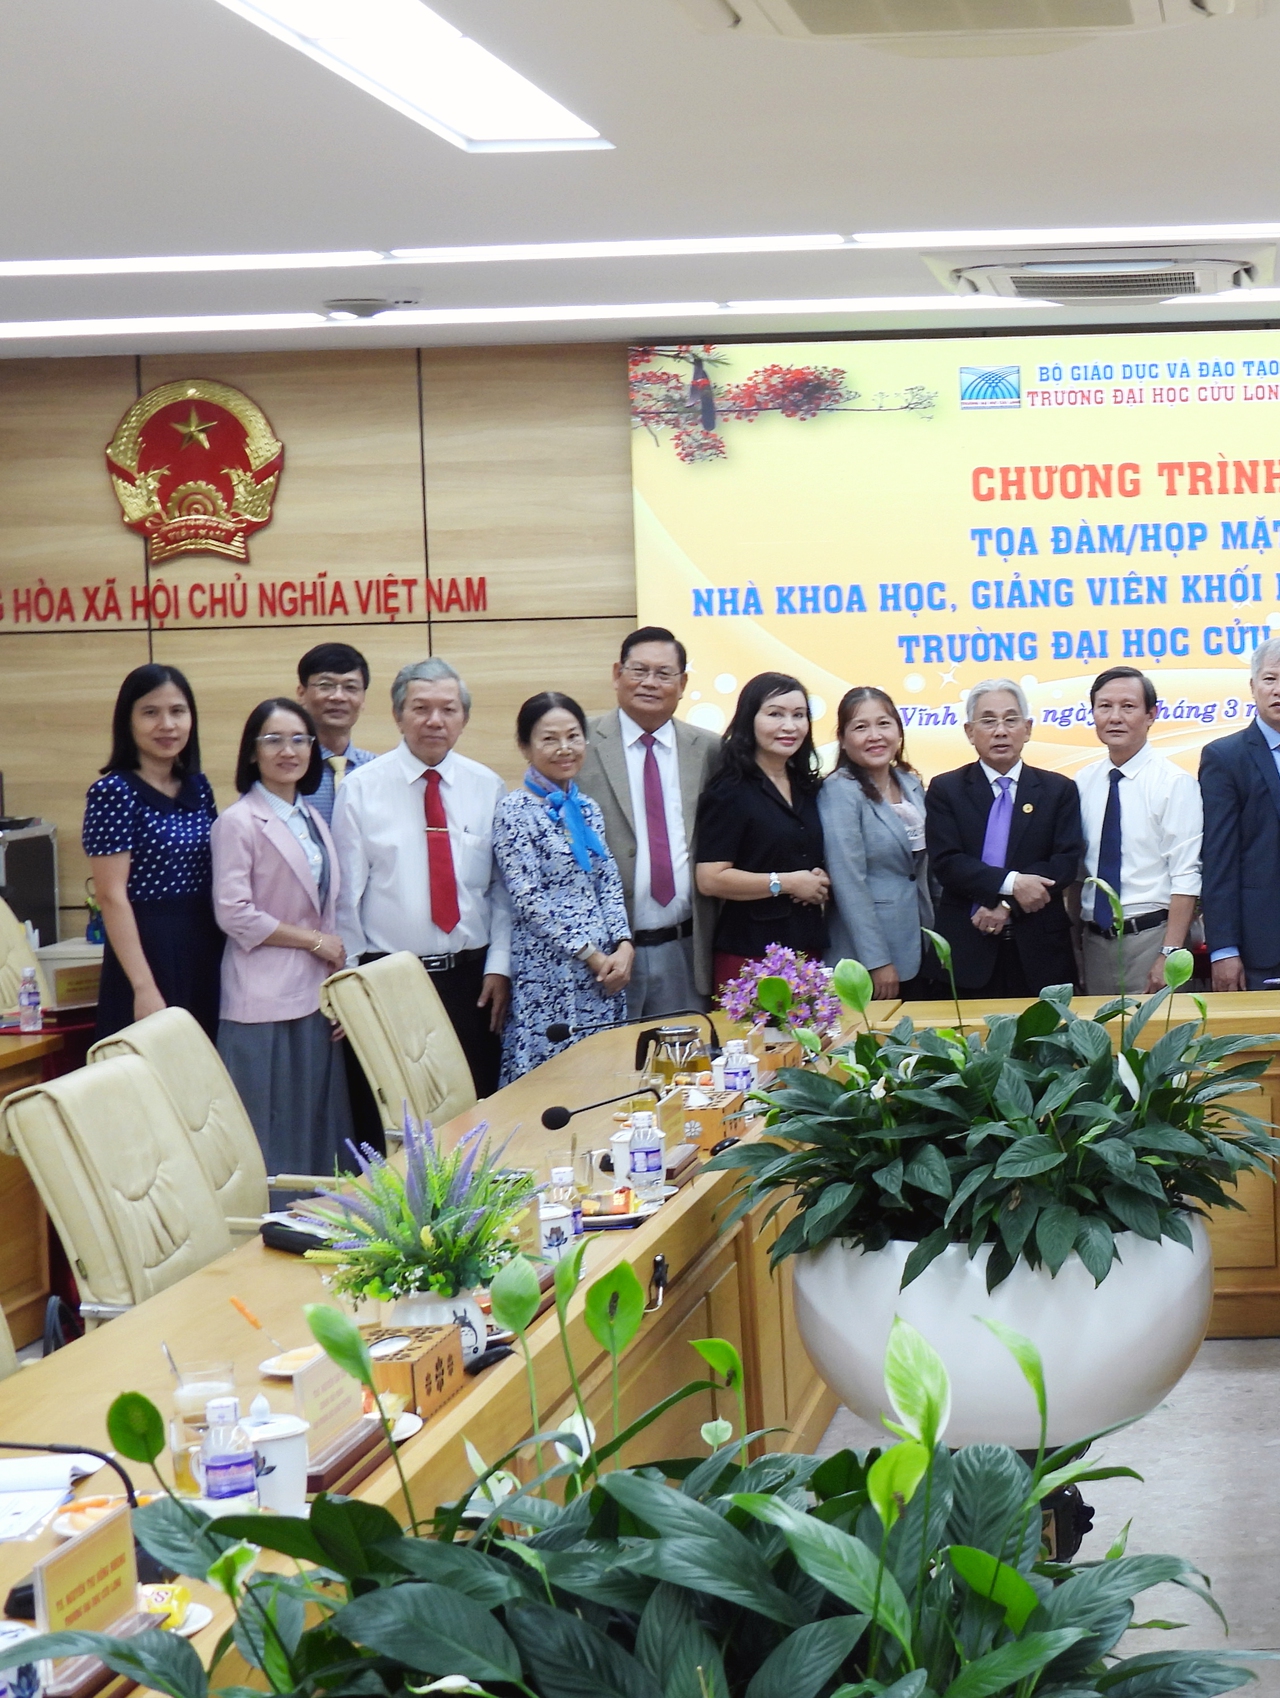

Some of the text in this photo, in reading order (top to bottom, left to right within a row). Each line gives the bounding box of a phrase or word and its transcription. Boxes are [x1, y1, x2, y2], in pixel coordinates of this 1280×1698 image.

[1039, 358, 1279, 386] BỘ GIÁO DỤC VÀ ĐÀO TẠO
[1027, 386, 1104, 406] TRƯỜNG
[1112, 388, 1144, 408] ĐẠI
[1152, 387, 1189, 407] HỌC
[1198, 381, 1235, 401] CỬU
[972, 462, 1141, 502] CHƯƠNG
[970, 526, 1039, 562] TỌA
[1050, 519, 1208, 558] ĐÀM/HỌP
[11, 577, 76, 623] HÒA
[81, 577, 123, 622] XÃ
[130, 578, 180, 629] HỘI
[187, 573, 248, 619] CHỦ
[258, 571, 349, 618] NGHĨA
[354, 573, 418, 623] VIỆT
[426, 576, 488, 613] NAM
[692, 581, 764, 616] NHÀ
[776, 583, 868, 614] KHOA
[879, 582, 958, 618] HỌC,
[971, 572, 1074, 610] GIẢNG
[1086, 571, 1167, 605] VIÊN
[1181, 565, 1263, 602] KHỐI
[898, 627, 1038, 664] TRƯỜNG
[1050, 629, 1109, 665] ĐẠI
[1122, 626, 1190, 663] HỌC
[1202, 618, 1272, 656] CỬU
[899, 705, 958, 727] Vĩnh
[1154, 700, 1218, 724] háng
[1224, 699, 1238, 719] 3
